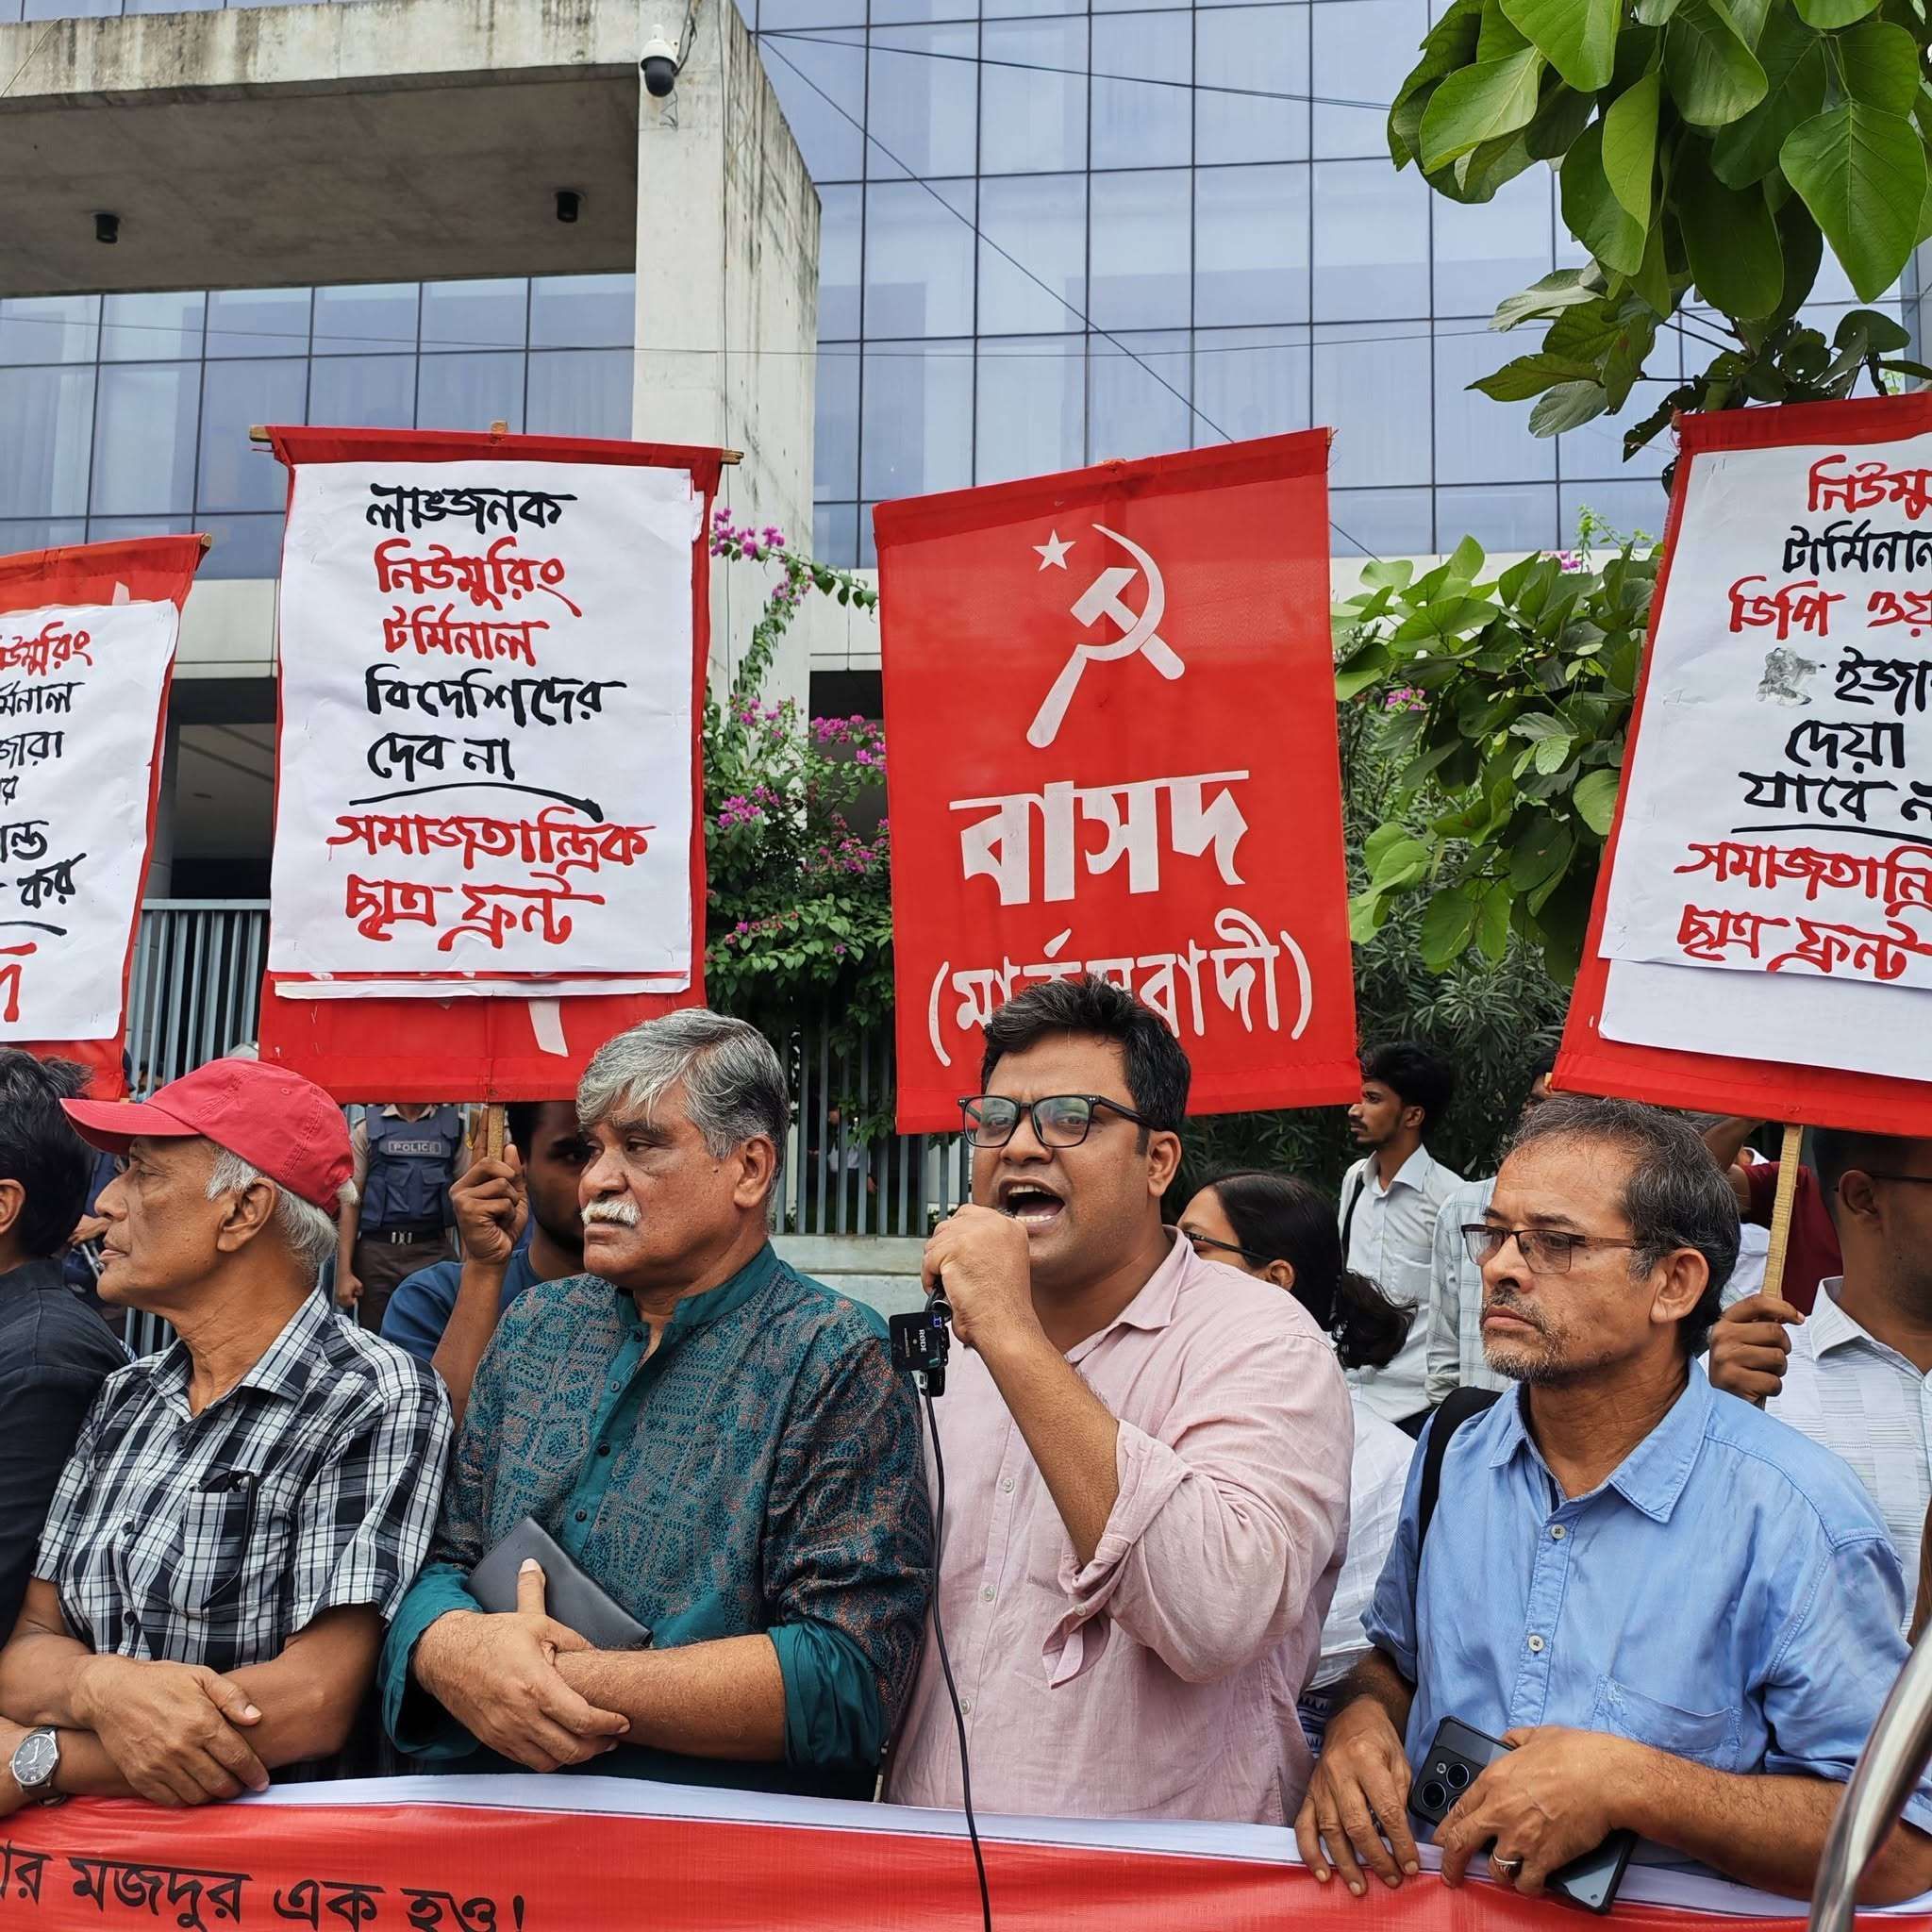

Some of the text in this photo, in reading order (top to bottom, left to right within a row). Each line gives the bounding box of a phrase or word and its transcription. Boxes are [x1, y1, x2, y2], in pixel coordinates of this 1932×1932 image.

[1807, 454, 1932, 520] নিউমু
[375, 536, 582, 617] নিউমুরিং
[1782, 519, 1932, 575] টার্মিনা
[1728, 575, 1846, 641] ডিপি
[366, 664, 627, 728] বিদেশিদের
[1834, 646, 1932, 716] ইজা
[367, 732, 515, 782] দেব না
[1738, 771, 1898, 823] যাবে
[948, 770, 1249, 906] বাসদ
[17, 853, 86, 908] কর
[67, 1857, 253, 1932] মজদুর
[274, 1878, 386, 1932] এক
